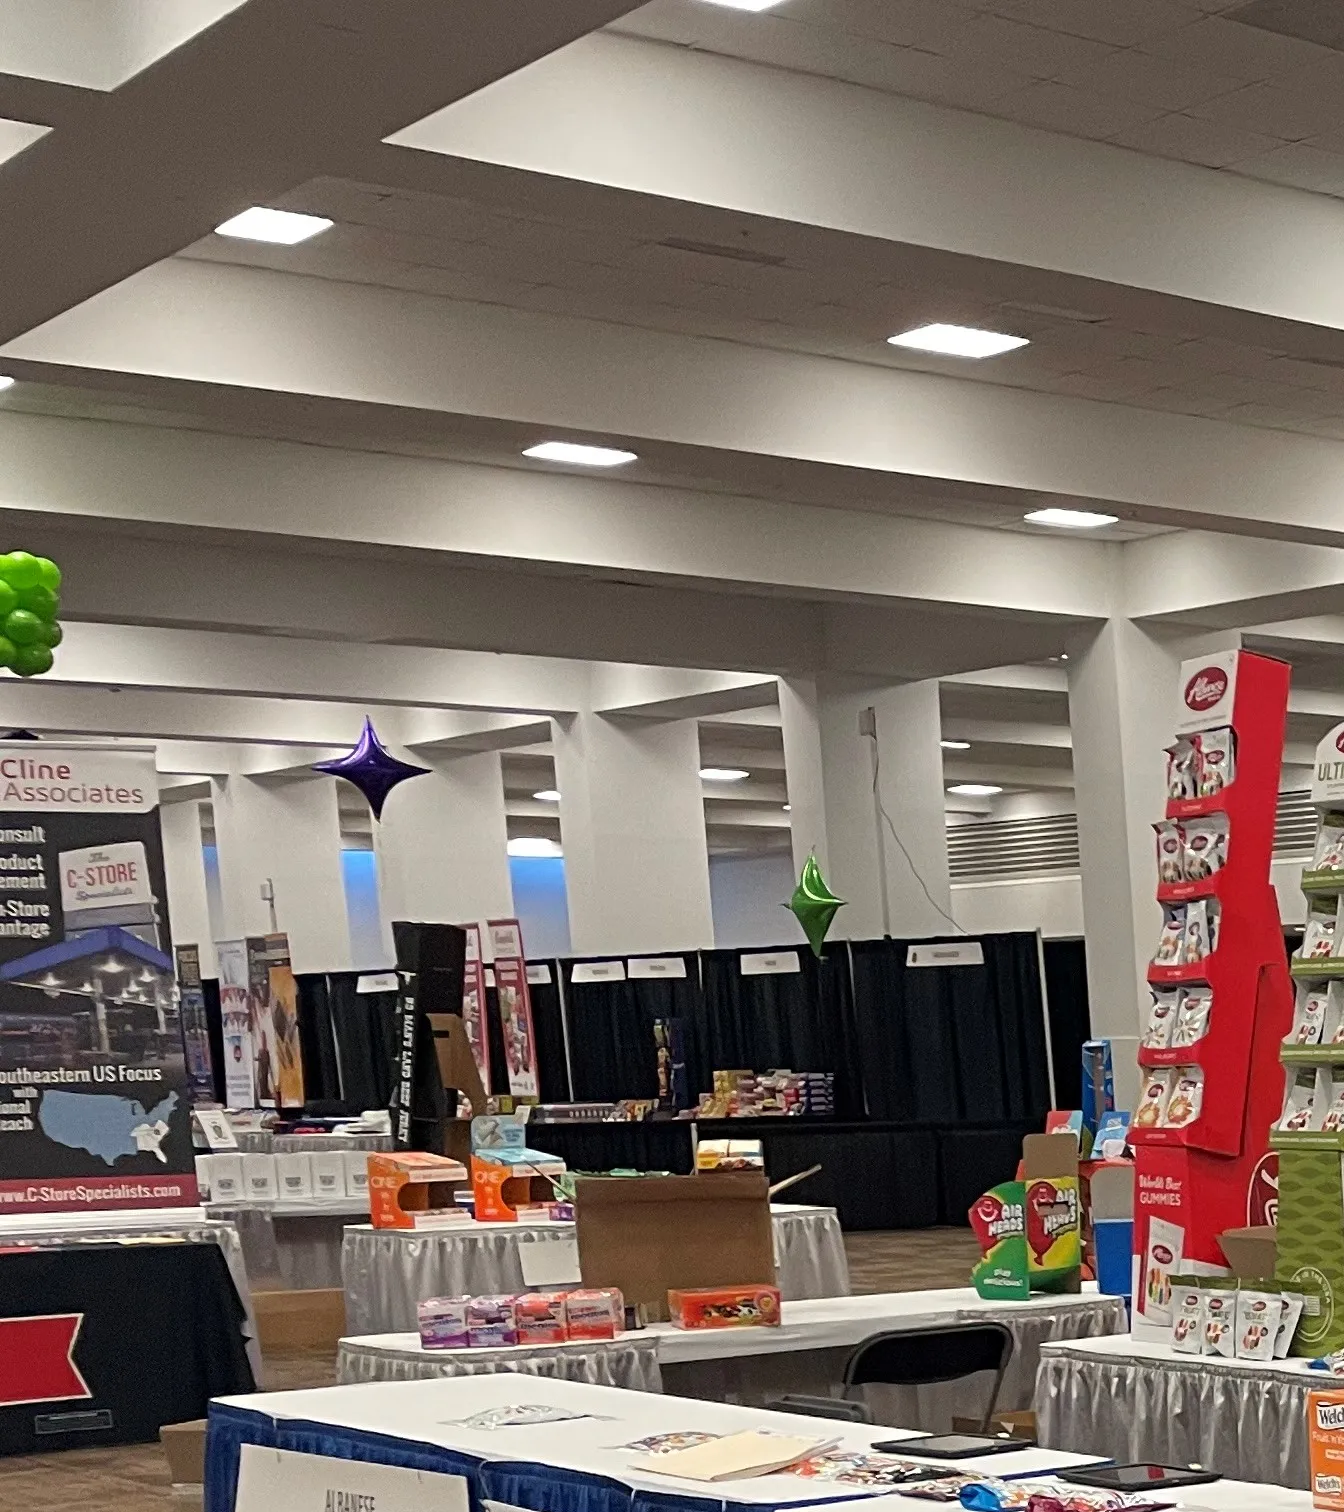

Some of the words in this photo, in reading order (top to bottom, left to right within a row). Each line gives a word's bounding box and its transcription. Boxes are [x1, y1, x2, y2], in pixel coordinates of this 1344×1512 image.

[1, 759, 71, 780] Cline
[3, 782, 144, 803] Associates
[66, 861, 138, 888] C-STORE
[92, 1065, 119, 1082] US
[118, 1065, 162, 1082] Focus
[1139, 1191, 1182, 1207] GUMMIES
[1001, 1203, 1023, 1218] AIR
[1312, 1432, 1330, 1443] Fruit
